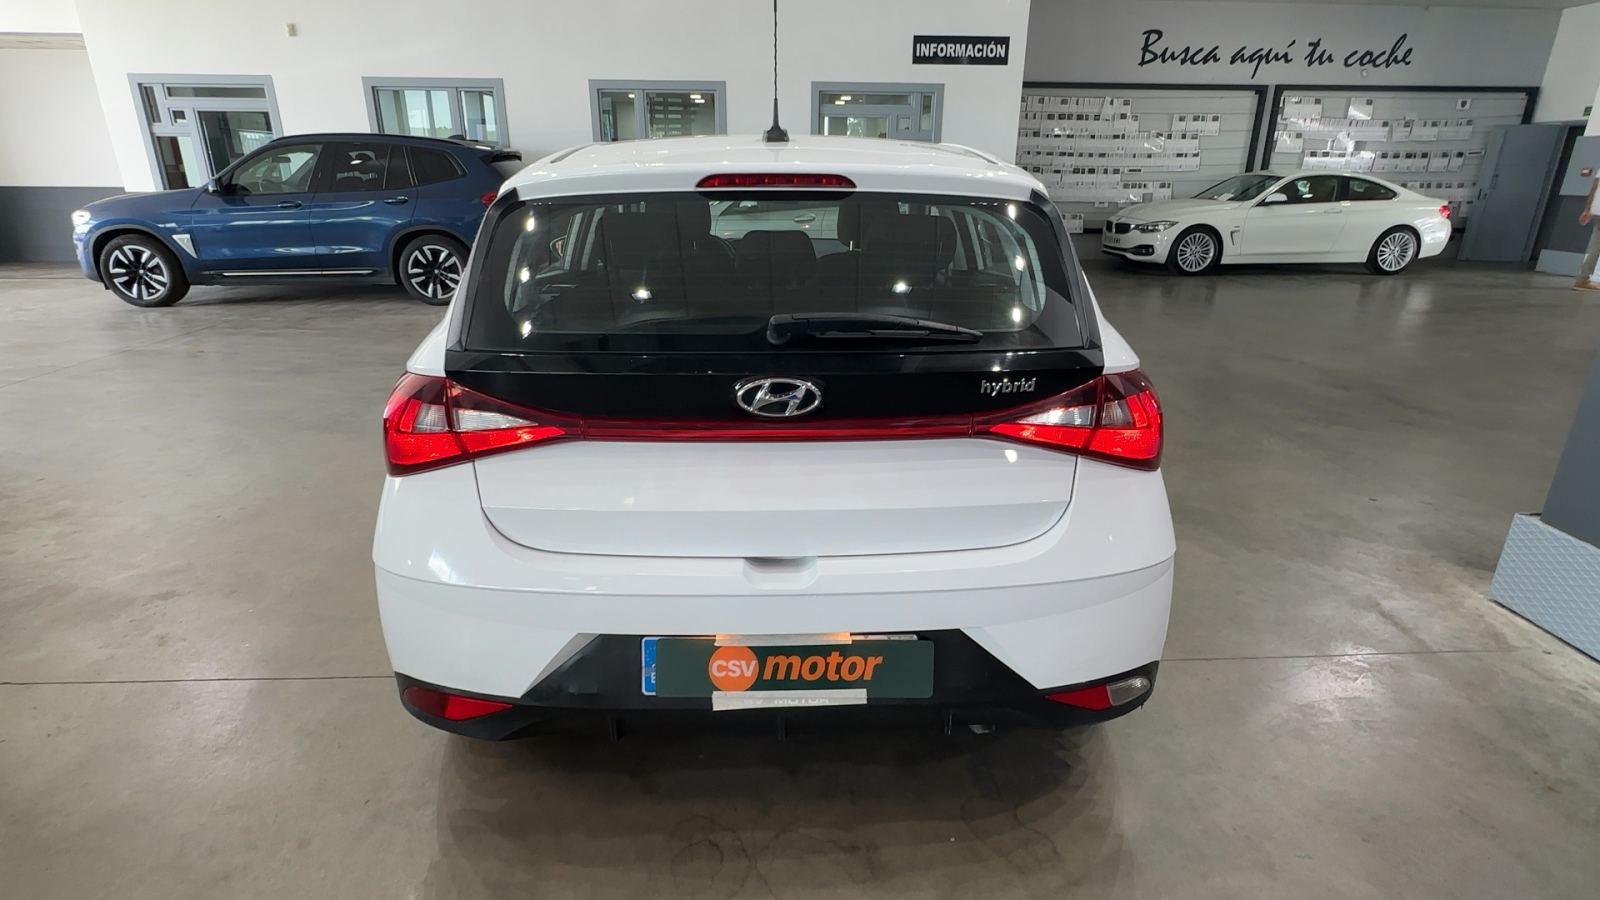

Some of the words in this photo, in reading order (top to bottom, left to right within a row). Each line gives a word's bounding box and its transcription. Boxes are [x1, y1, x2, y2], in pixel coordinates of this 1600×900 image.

[915, 40, 1006, 58] INFORMACIÓN
[1138, 29, 1221, 67] Busca
[1229, 40, 1296, 80] aquí
[1304, 37, 1334, 67] tu
[1343, 33, 1413, 69] coche
[980, 377, 1036, 397] hybrid
[711, 659, 758, 678] CSV
[763, 651, 883, 681] motor
